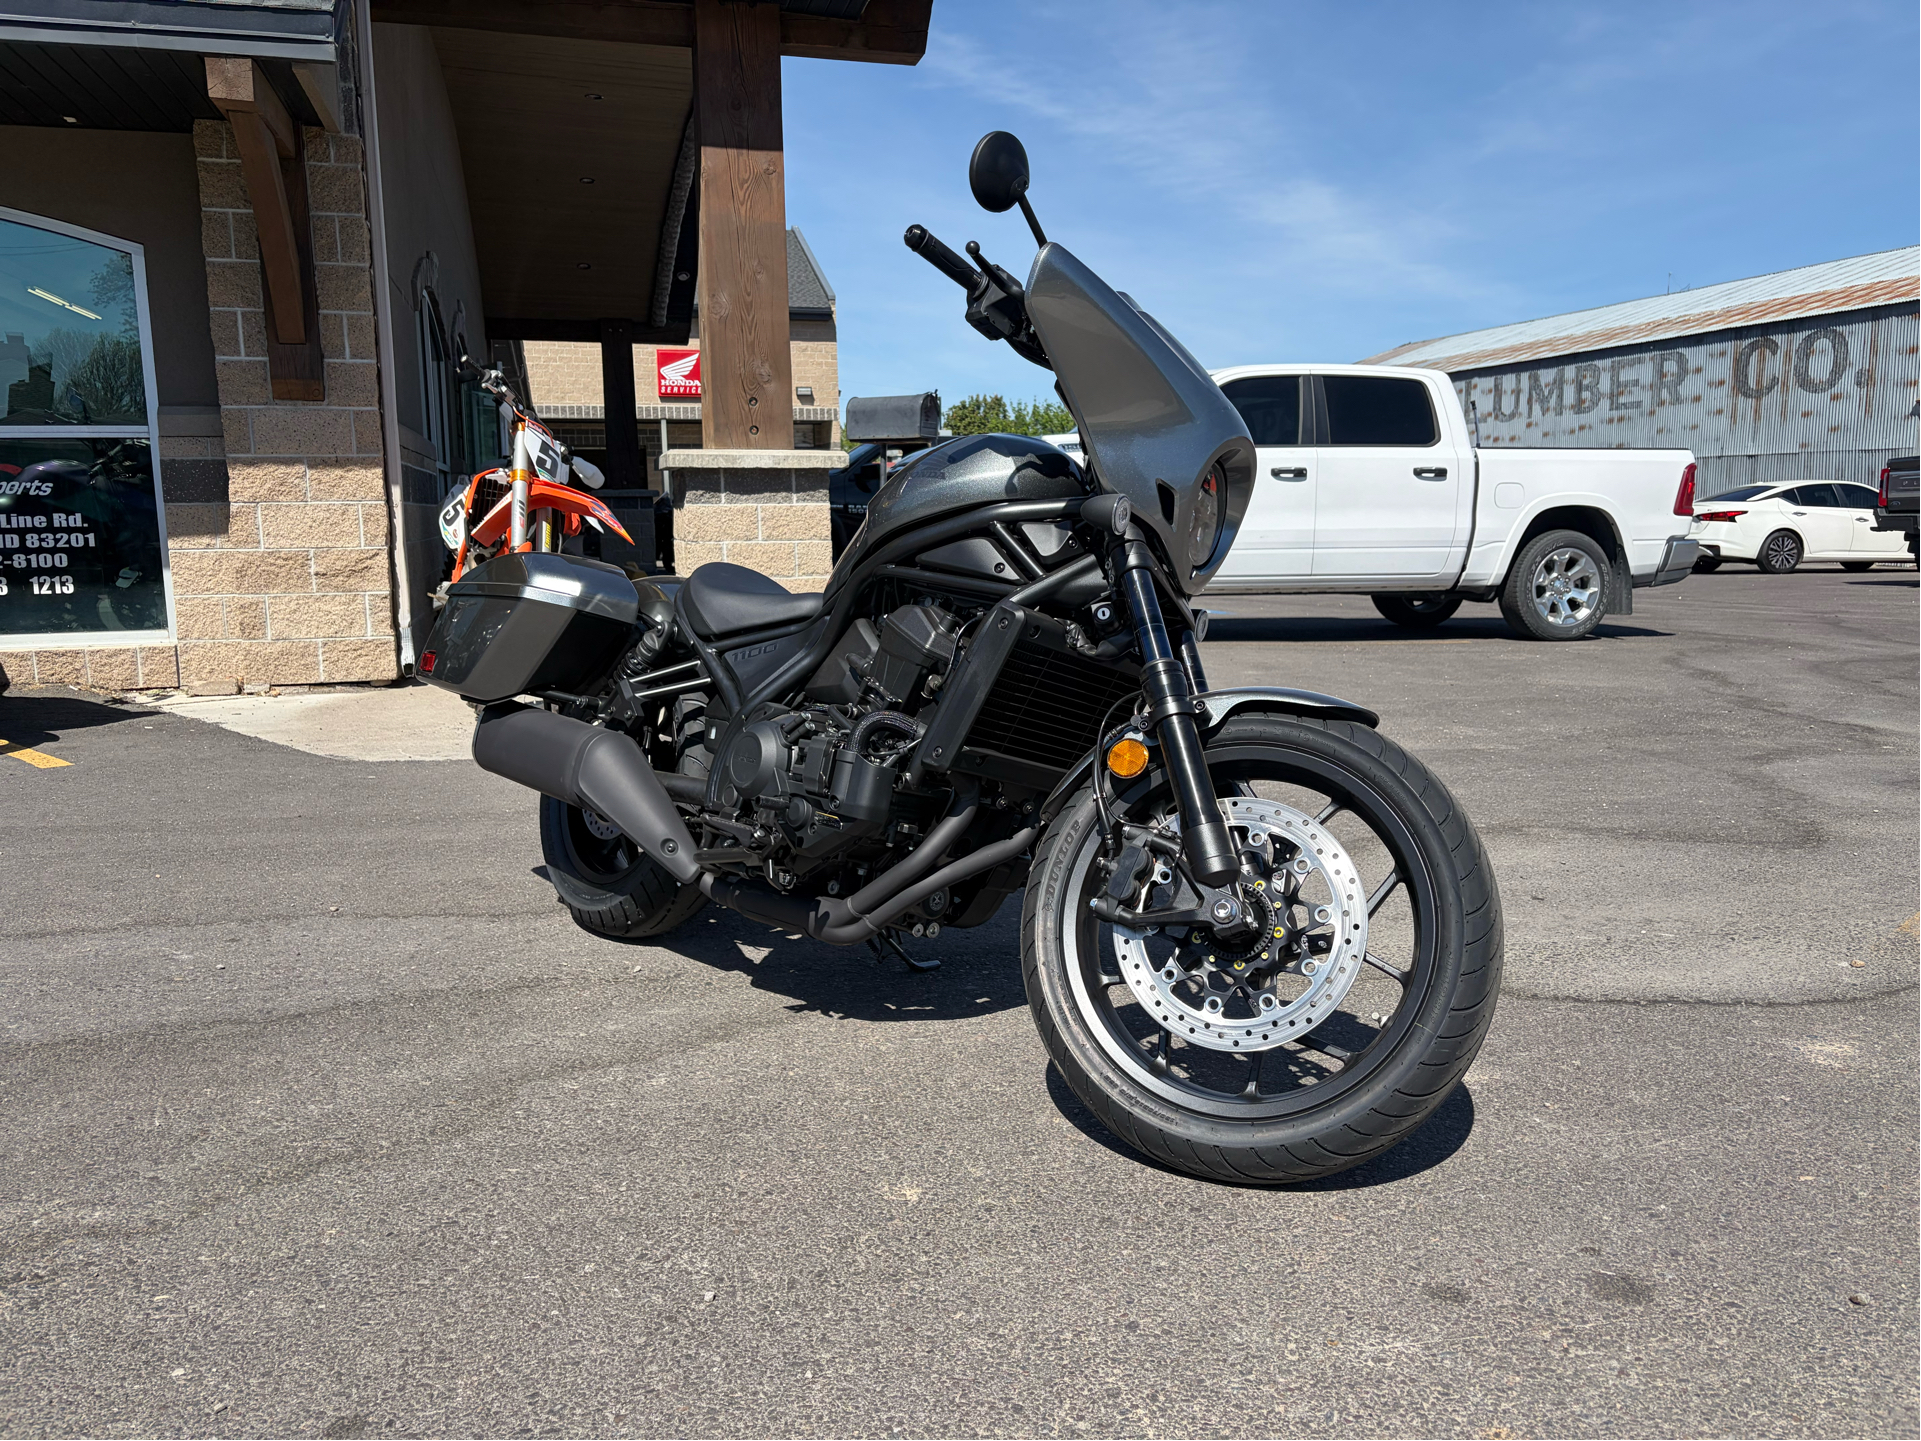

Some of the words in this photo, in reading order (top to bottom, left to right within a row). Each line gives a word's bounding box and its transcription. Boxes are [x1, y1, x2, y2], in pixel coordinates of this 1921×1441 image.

[1463, 350, 1690, 426] LUMBER
[1734, 326, 1871, 400] CO.
[660, 386, 702, 394] SERVICE
[535, 440, 560, 479] 5
[0, 513, 47, 528] Line
[52, 513, 88, 527] Rd.
[442, 497, 466, 527] 5
[25, 532, 96, 548] 83201
[29, 575, 75, 595] 1213
[731, 643, 779, 662] 1100
[1045, 819, 1081, 898] DUNLOP
